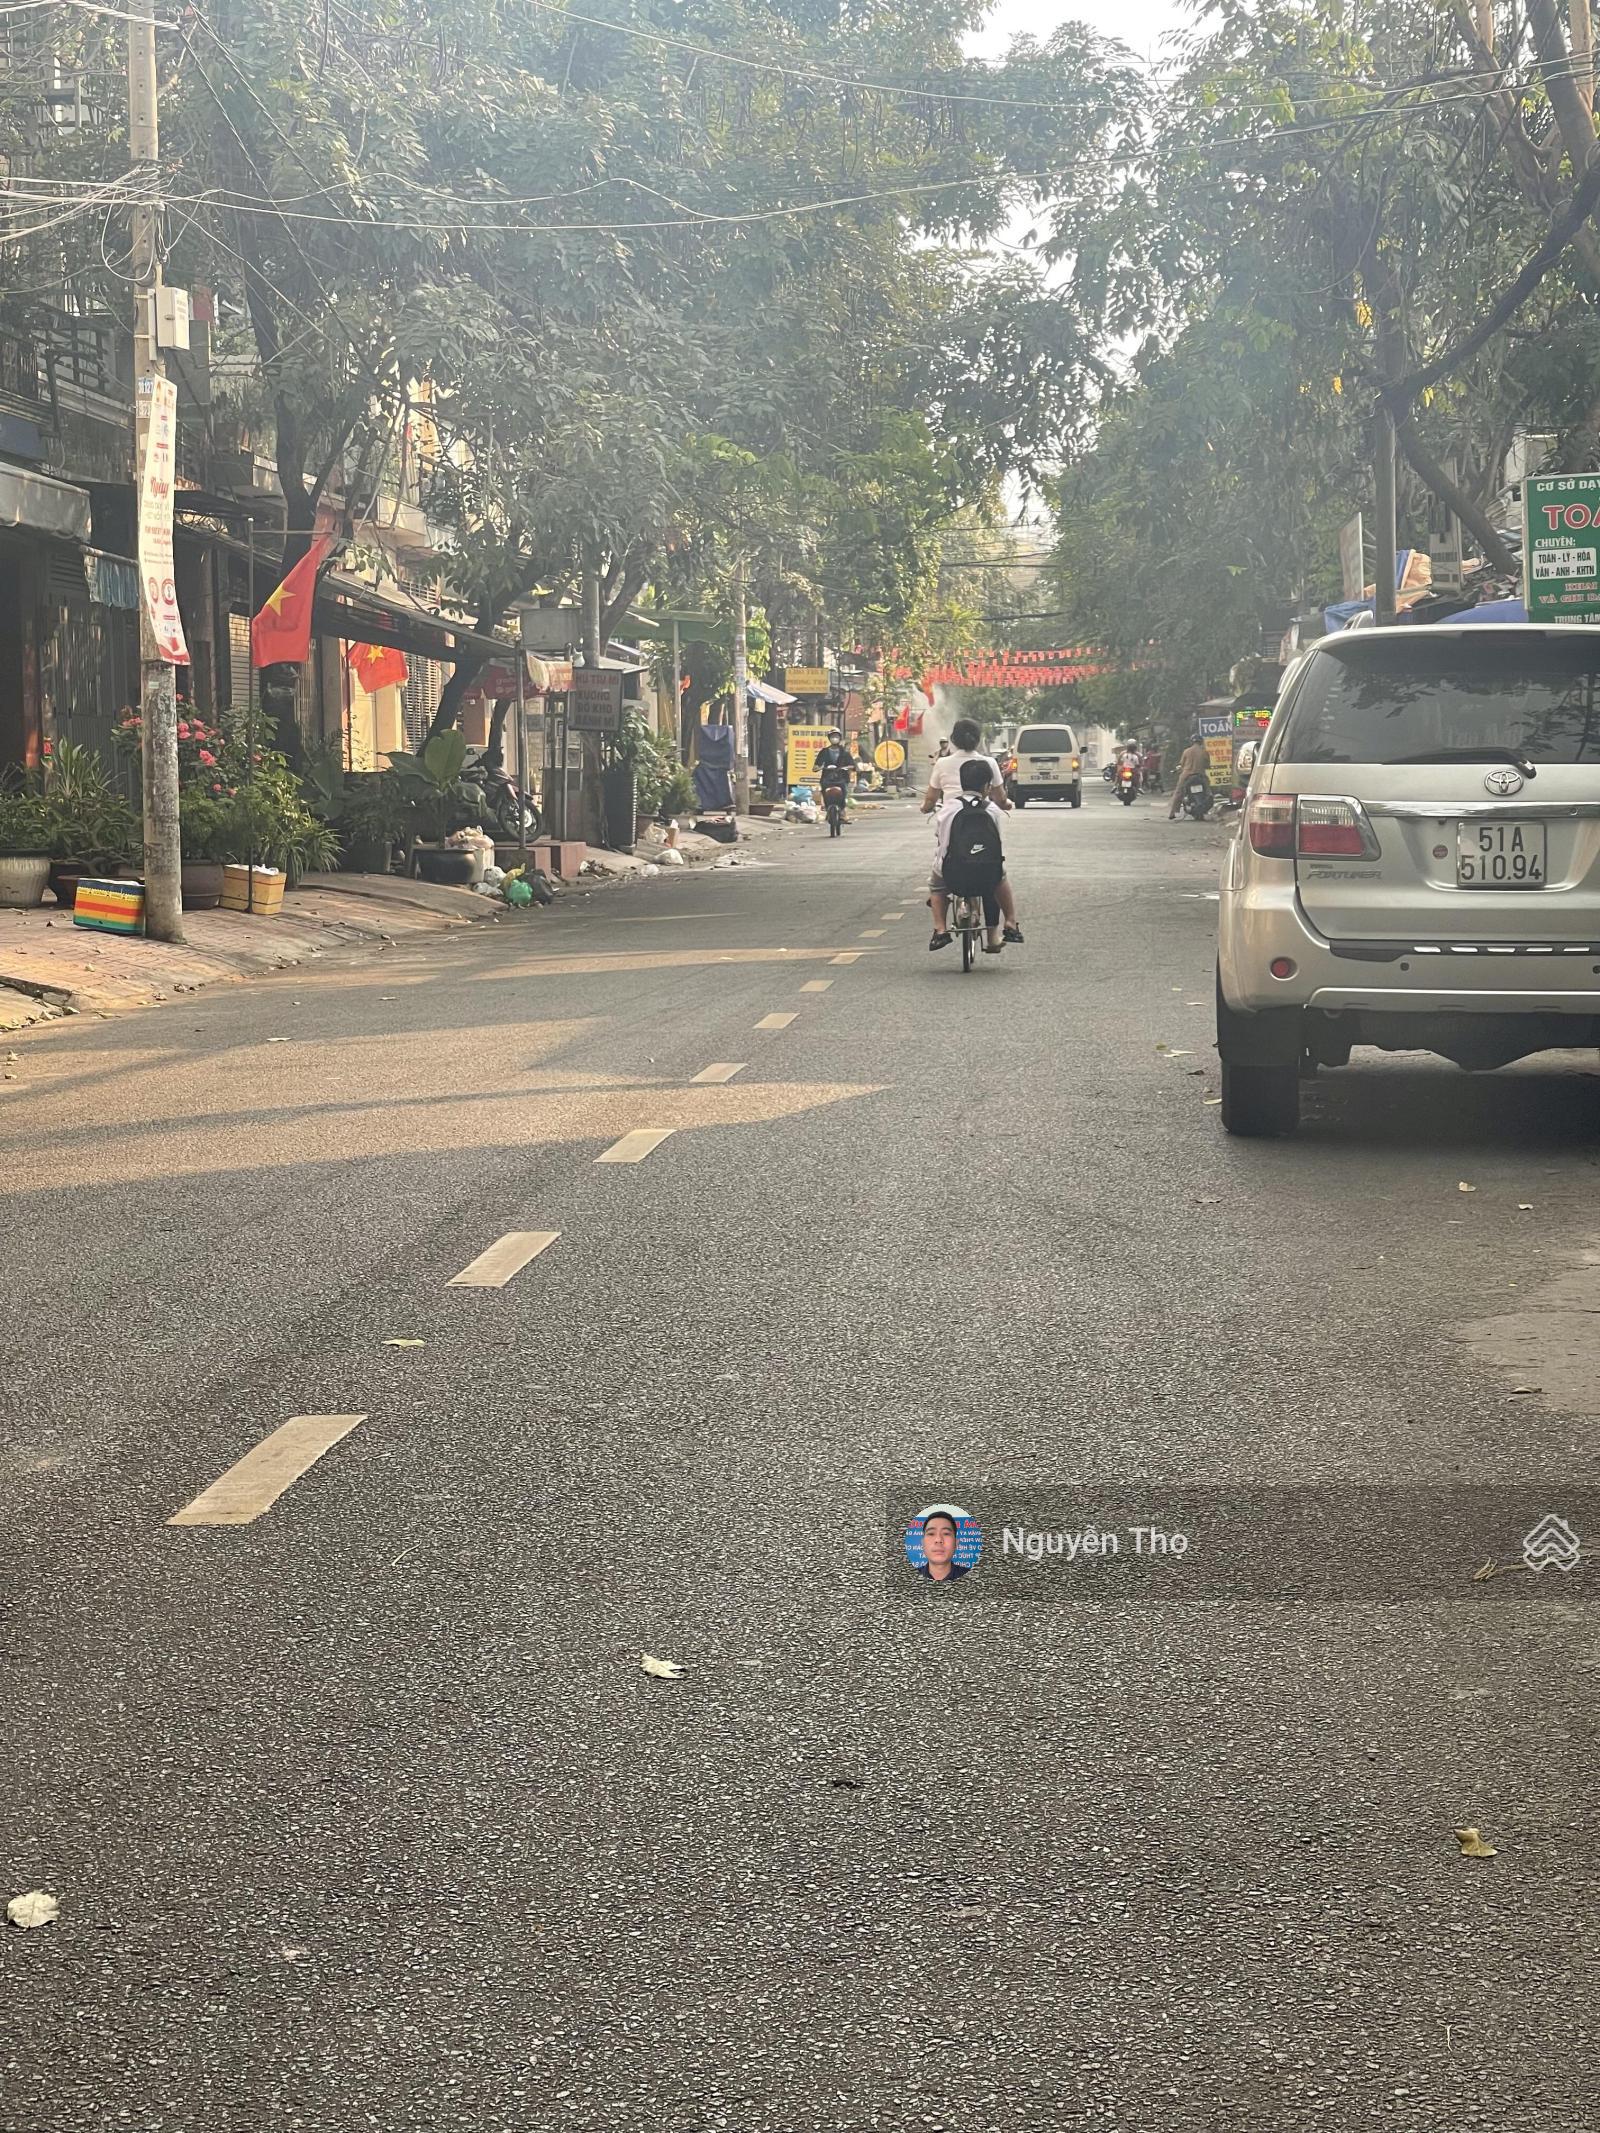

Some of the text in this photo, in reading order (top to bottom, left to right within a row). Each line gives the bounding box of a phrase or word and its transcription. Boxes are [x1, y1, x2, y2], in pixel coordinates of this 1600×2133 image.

[1536, 481, 1554, 492] CƠ
[1558, 478, 1575, 490] SỞ
[1554, 614, 1583, 624] TRUNG
[1479, 826, 1524, 852] 51A
[1460, 854, 1542, 880] 510.94
